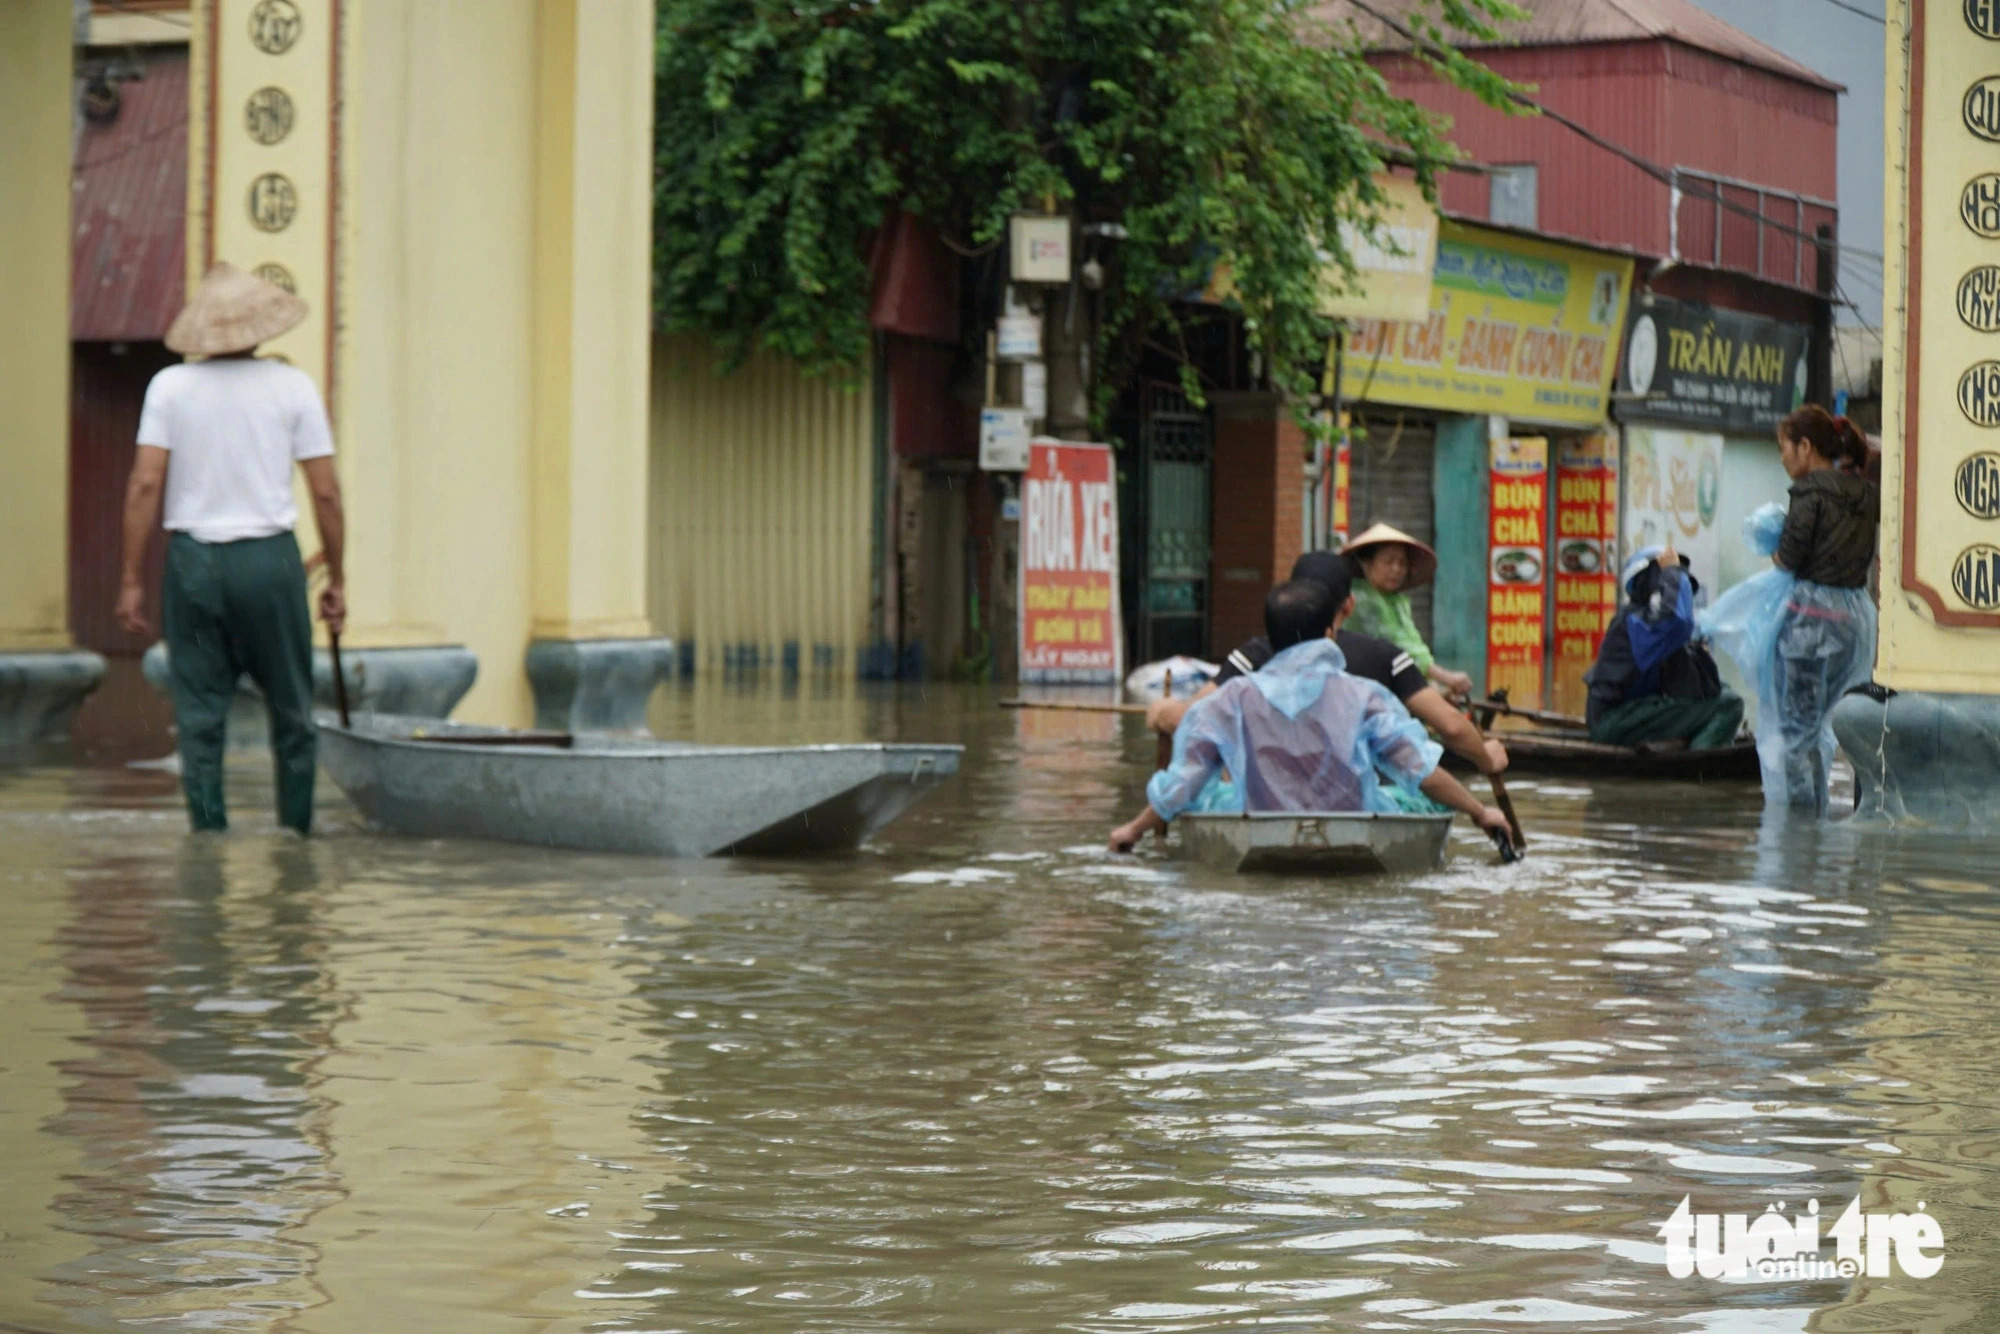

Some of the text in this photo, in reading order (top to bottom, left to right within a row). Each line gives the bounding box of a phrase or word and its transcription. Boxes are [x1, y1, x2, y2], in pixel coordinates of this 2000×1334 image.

[1968, 84, 2000, 136] QU
[1668, 320, 1785, 385] TRẦN ANH
[1493, 479, 1541, 509] BÚN
[1560, 474, 1600, 500] BÚN
[1959, 457, 2000, 516] NGÀ
[1080, 481, 1114, 571] XE
[1494, 511, 1540, 543] CHẢ
[1560, 505, 1600, 534] CHẢ
[1491, 589, 1541, 616] BÁNH
[1491, 618, 1541, 646] CUỐN
